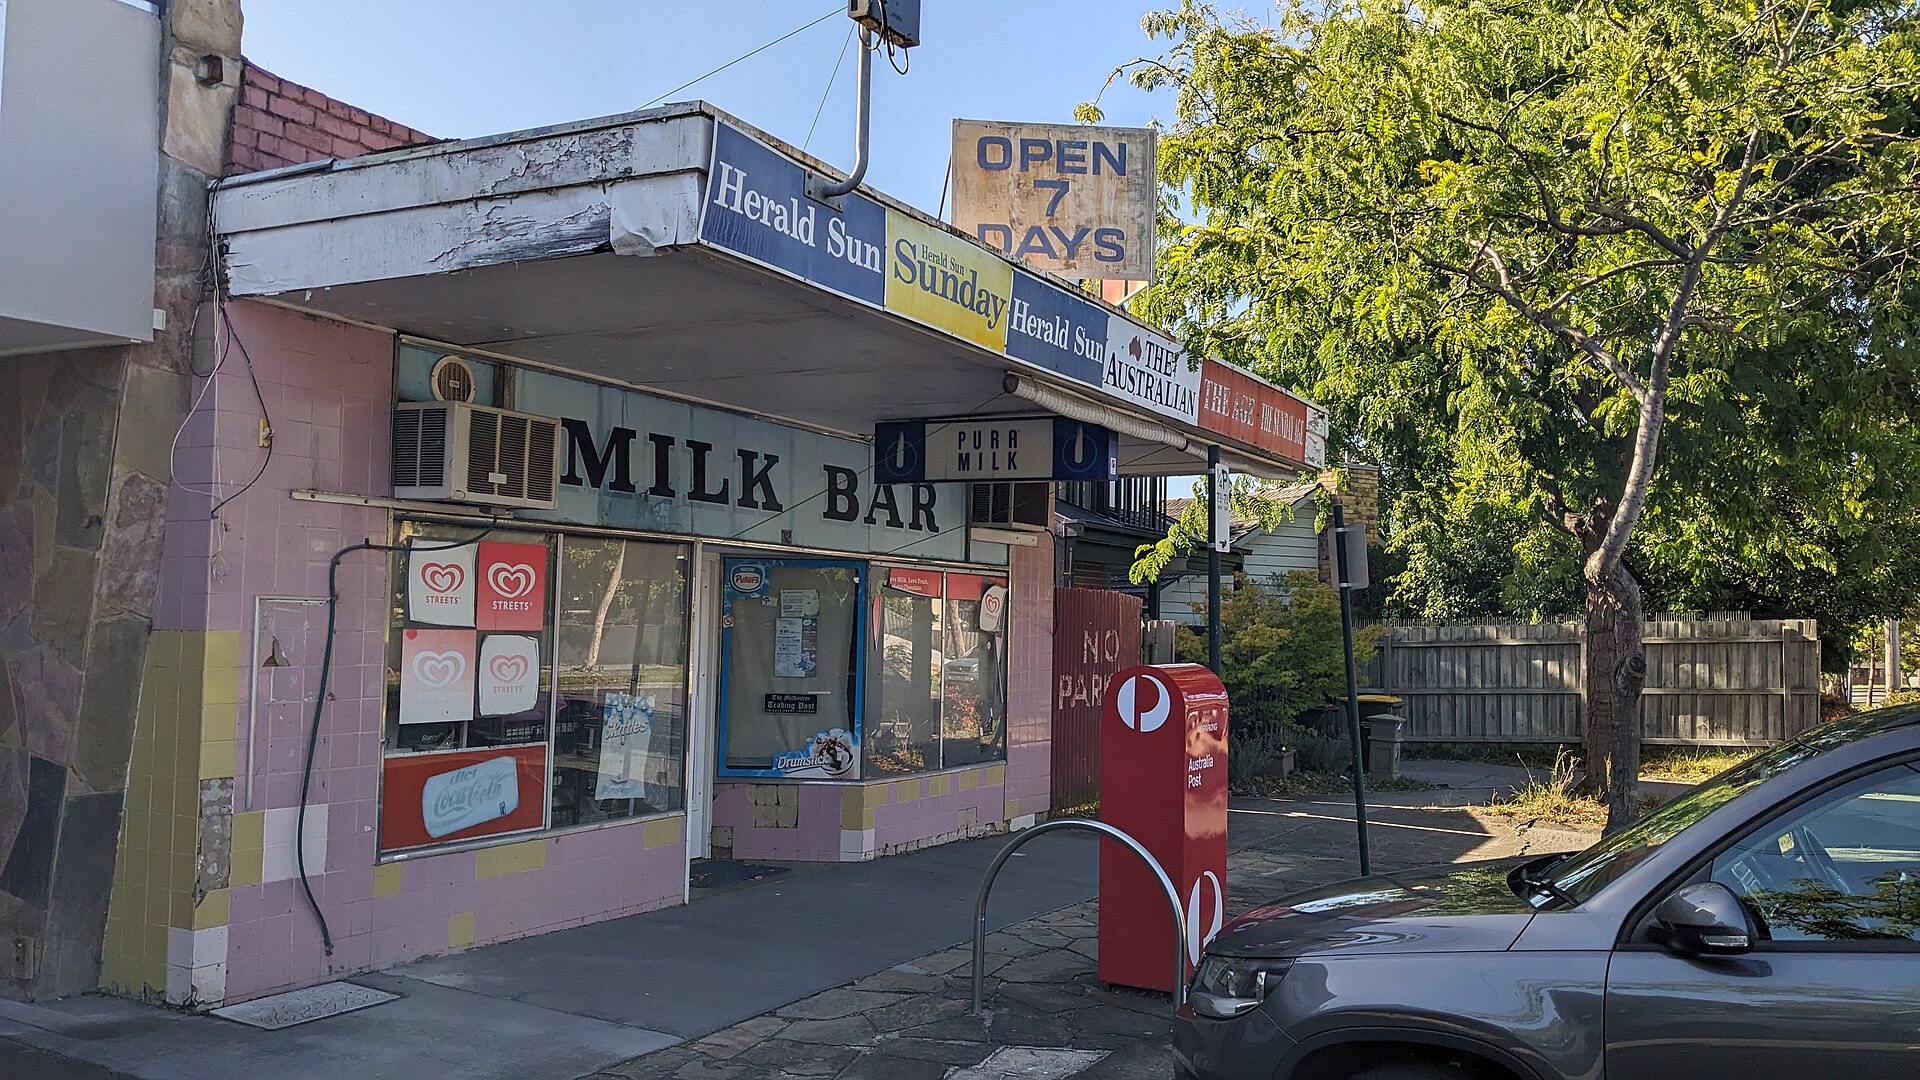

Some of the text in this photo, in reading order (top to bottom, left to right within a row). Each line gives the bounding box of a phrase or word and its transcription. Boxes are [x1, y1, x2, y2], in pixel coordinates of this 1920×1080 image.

[976, 136, 1127, 176] OPEN
[1034, 180, 1069, 217] 7
[714, 161, 881, 273] Herald Sun
[977, 223, 1125, 262] DAYS
[921, 244, 965, 275] Herald Sun
[894, 238, 1007, 329] Sunday
[1010, 297, 1104, 364] Herald Sun
[1145, 340, 1174, 377] THE
[1104, 352, 1196, 417] AUSTRALIAN
[1203, 378, 1255, 426] THE AGE
[1260, 402, 1273, 433] THE
[958, 429, 1018, 450] PURA
[560, 417, 940, 533] MILK BAR
[958, 451, 1017, 471] MILK
[735, 574, 760, 584] Peters
[425, 595, 459, 604] STREETS
[492, 600, 529, 611] STREETS
[1083, 630, 1119, 664] NO
[492, 686, 522, 694] STREETS
[767, 701, 815, 710] Trading Post
[777, 755, 829, 770] Drumstick
[1188, 754, 1214, 772] Australia
[1188, 772, 1202, 788] Post
